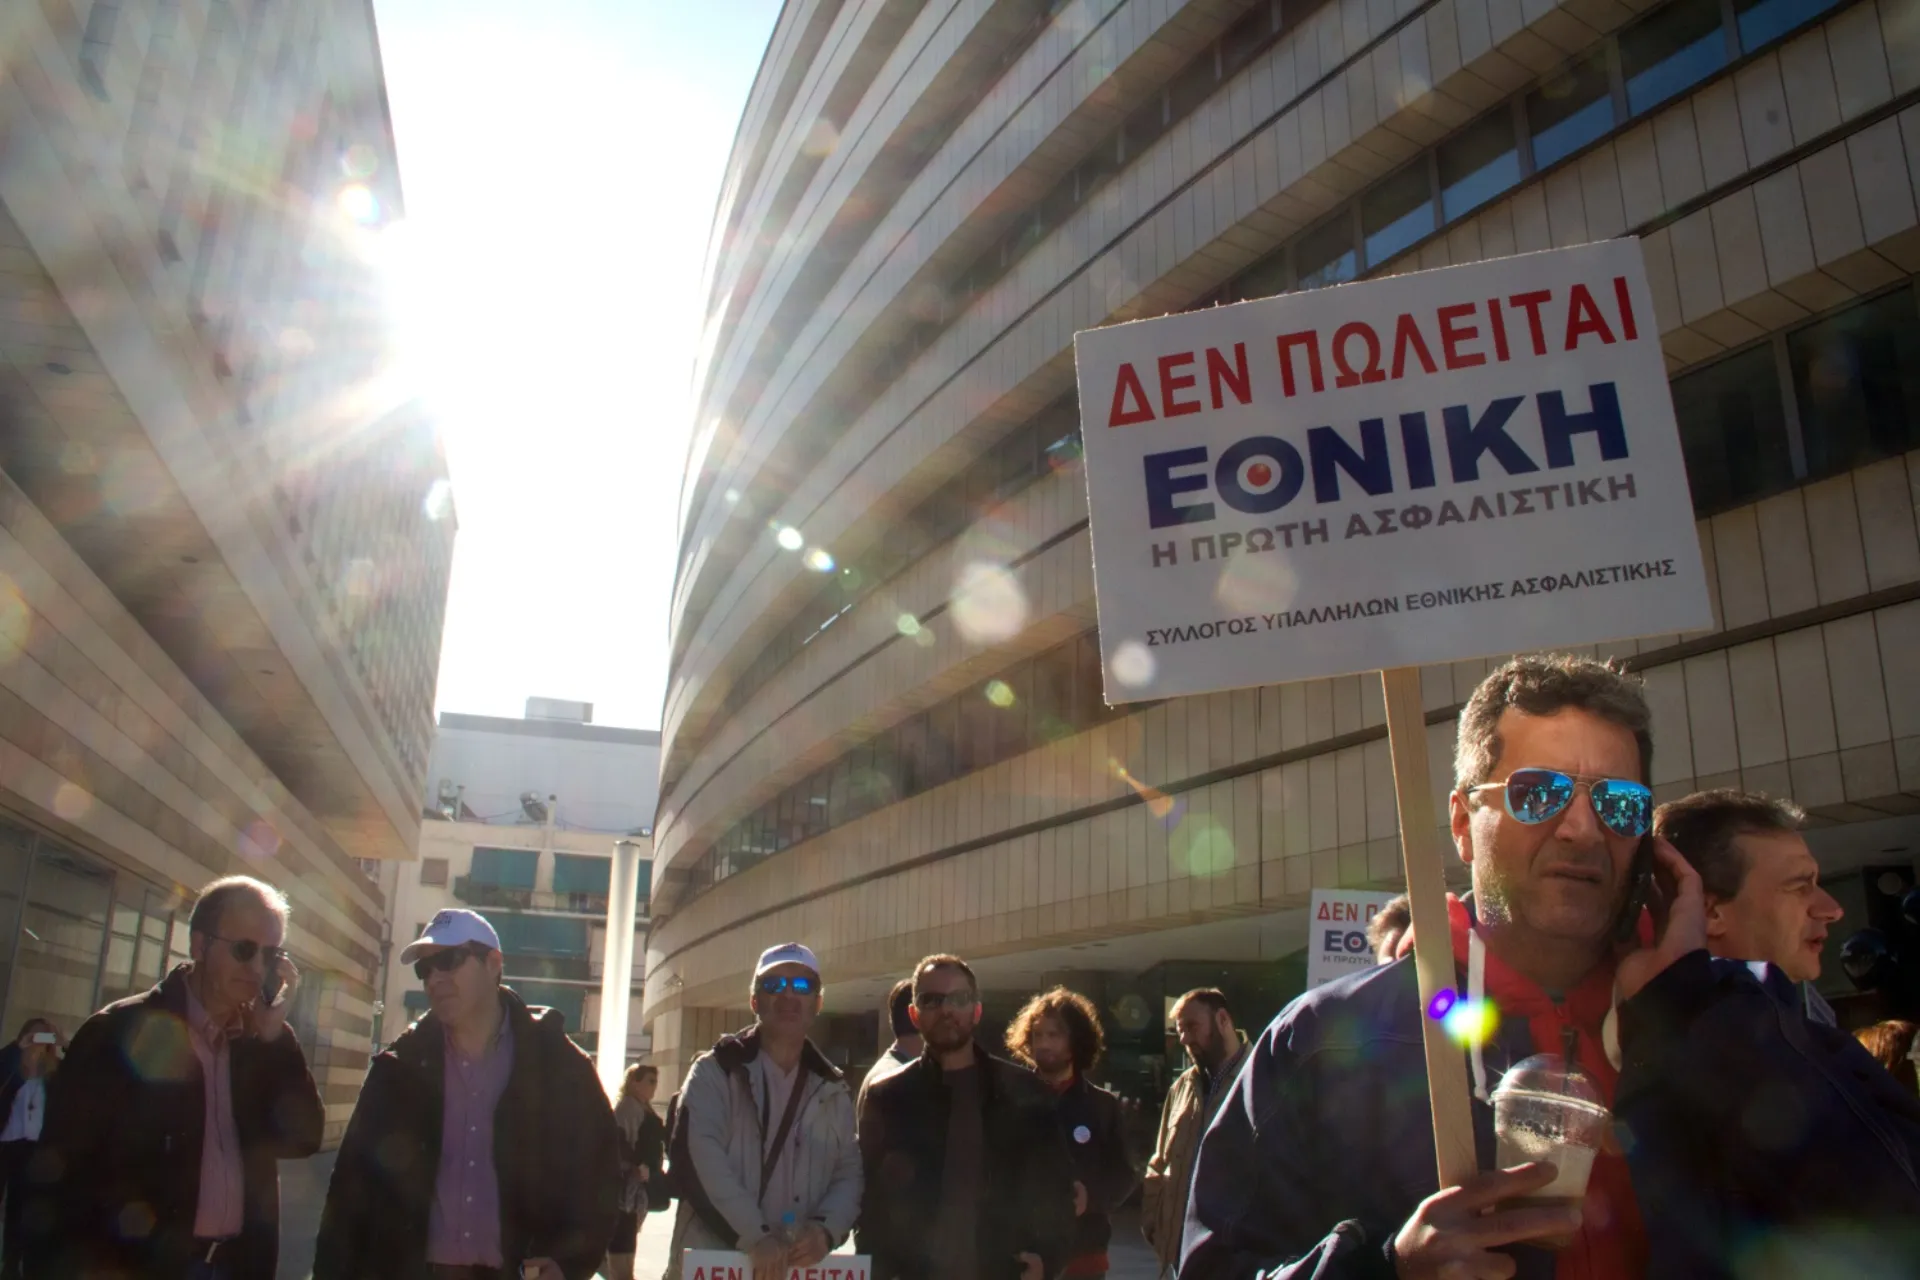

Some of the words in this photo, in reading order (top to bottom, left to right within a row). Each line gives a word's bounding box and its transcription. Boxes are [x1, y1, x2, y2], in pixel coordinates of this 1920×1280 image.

[1108, 342, 1252, 427] ΔΕΝ
[1277, 276, 1638, 397] ΠΩΛΕΙΤΑΙ
[1144, 382, 1629, 530] ΕΘΝΙΚΗ
[1152, 542, 1177, 568] Η
[1191, 518, 1330, 561] ΠΡΩΤΗ
[1344, 473, 1637, 539] ΑΣΦΑΛΙΣΤΙΚΗ
[1146, 615, 1258, 647] ΣΥΛΛΟΓΟΣ
[1263, 596, 1399, 630] ΥΠΑΛΛΗΛΩΝ
[1405, 581, 1504, 611] ΕΘΝΙΚΗΣ
[1510, 558, 1677, 596] ΑΣΦΑΛΙΣΤΙΚΗΣ
[1317, 902, 1358, 922] ΔΕΝ
